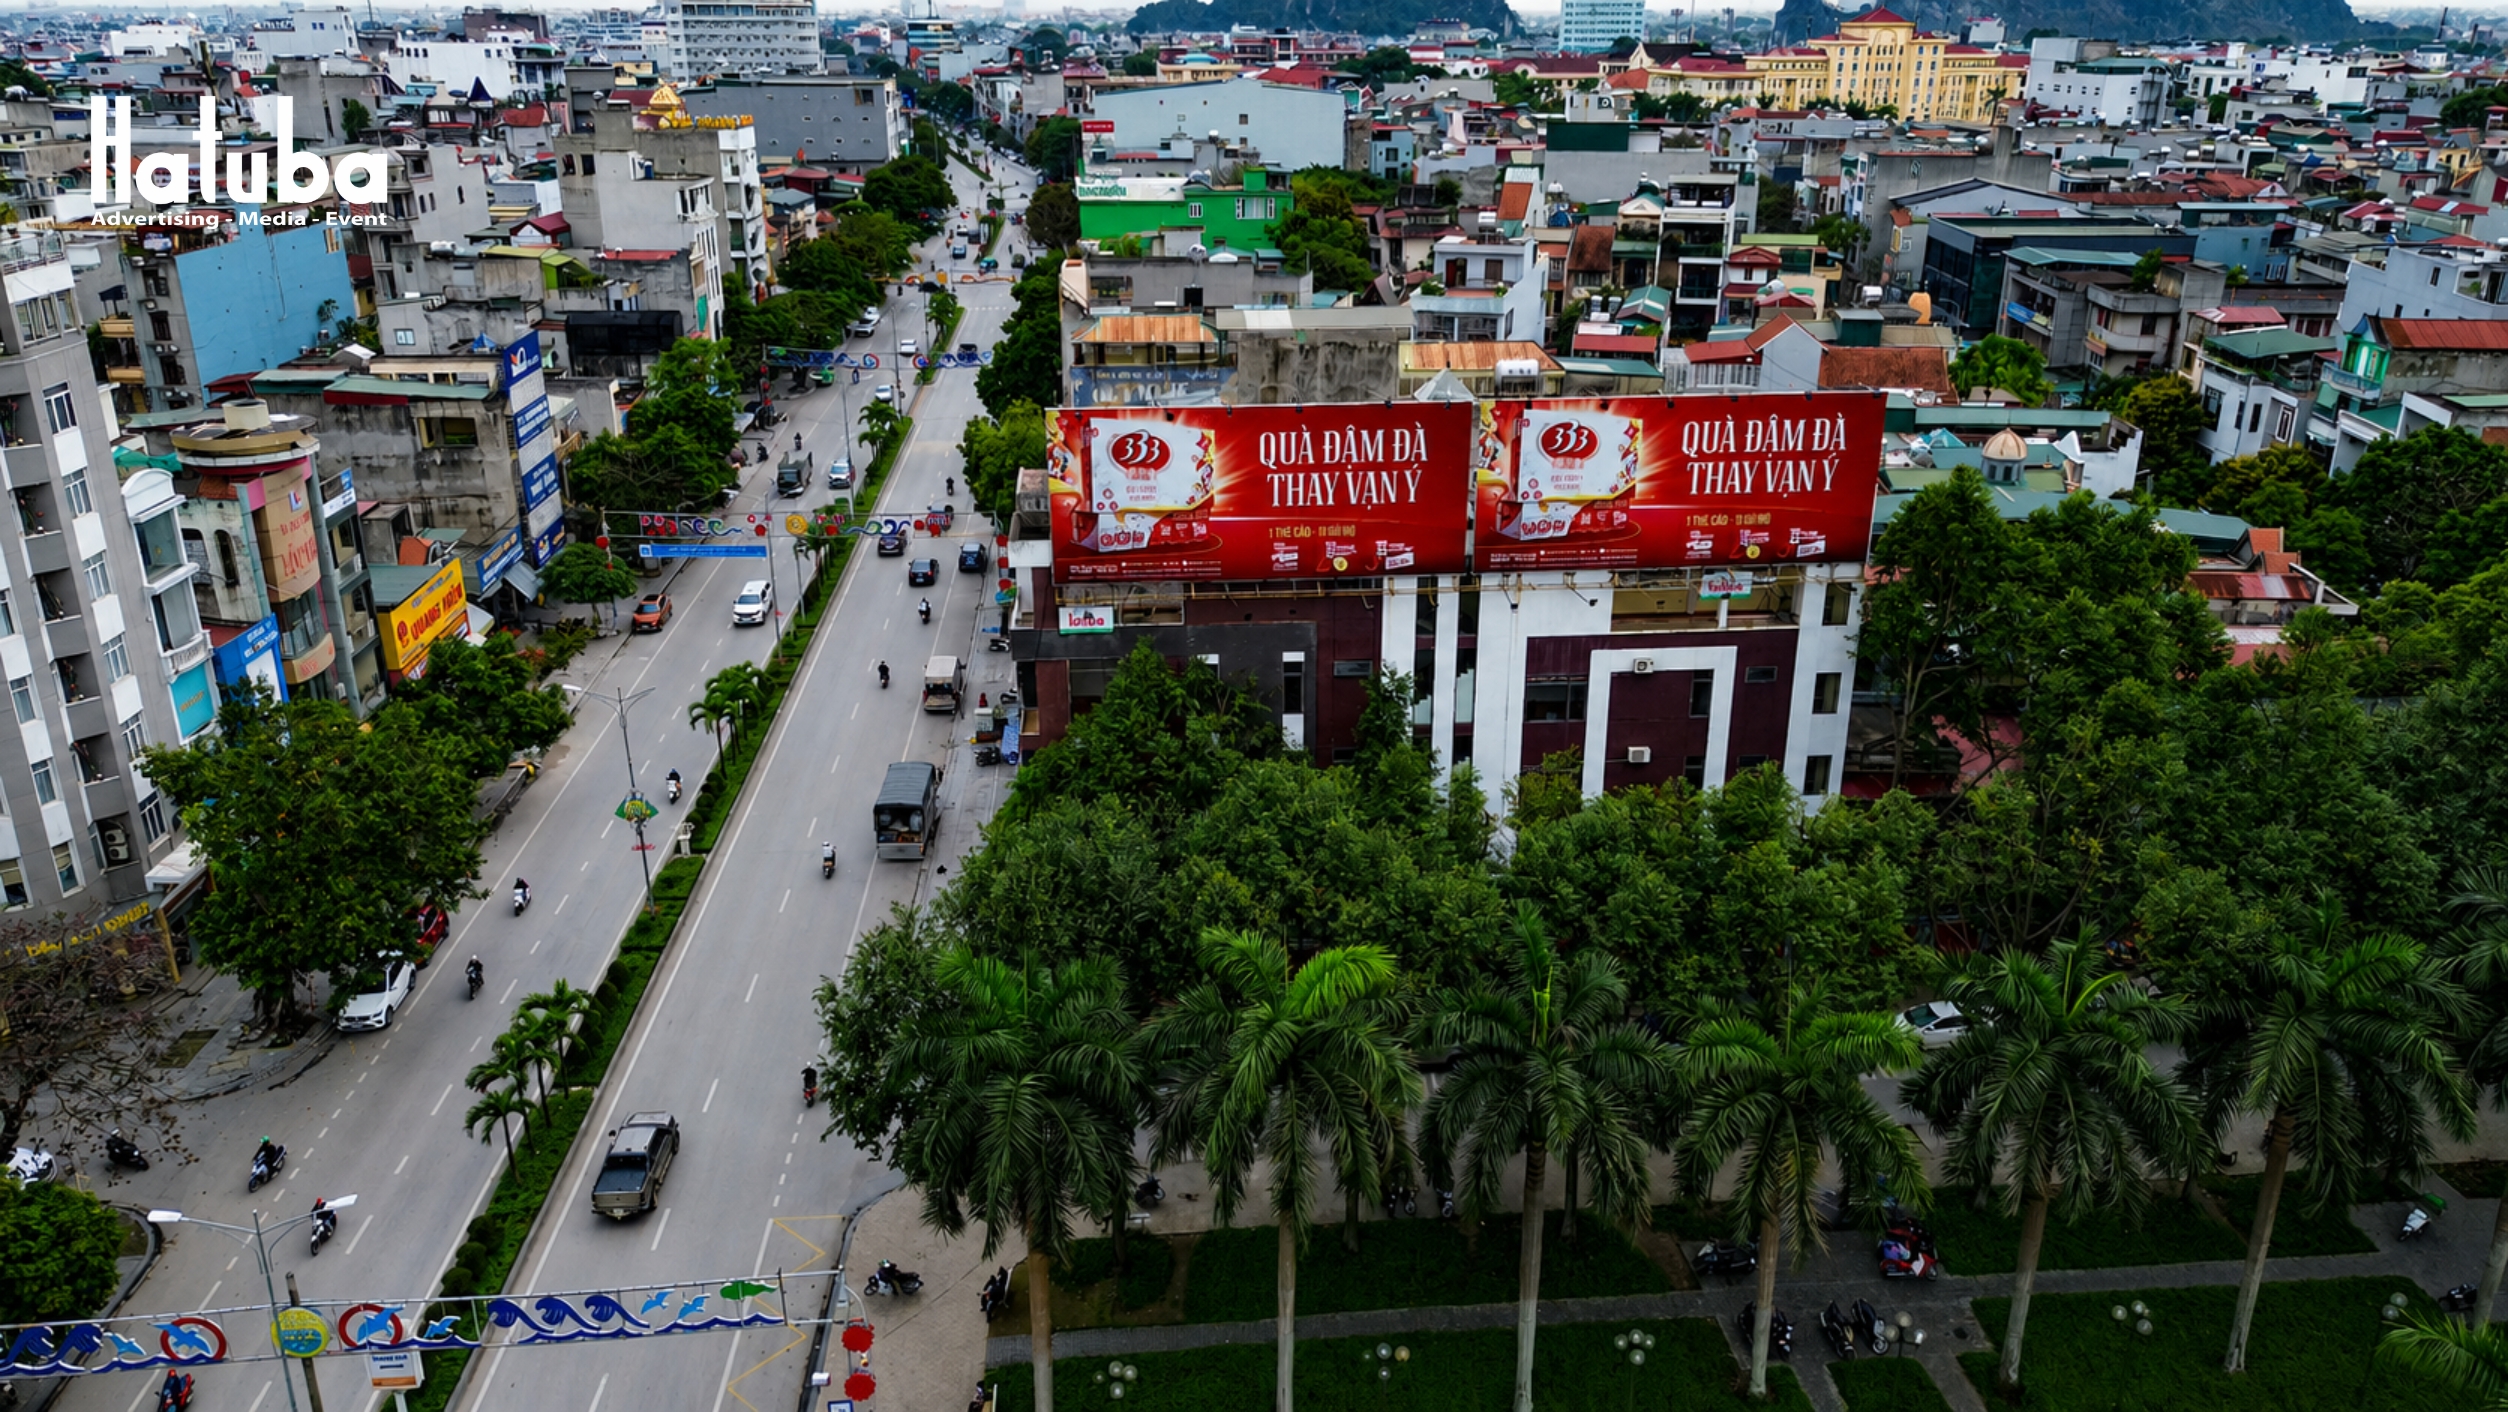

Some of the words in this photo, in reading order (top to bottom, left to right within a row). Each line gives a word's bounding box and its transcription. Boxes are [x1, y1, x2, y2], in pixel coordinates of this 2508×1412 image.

[1118, 430, 1162, 465] 333
[1259, 423, 1315, 470] QUÀ
[1392, 421, 1428, 463] ĐÀ
[1547, 420, 1590, 455] 333
[1681, 413, 1736, 458] QUÀ
[1811, 411, 1847, 452] ĐÀ
[1266, 472, 1341, 508] THAY
[1344, 470, 1398, 512] VẠN
[1403, 462, 1423, 504] Ý
[1686, 460, 1760, 496] THAY
[1764, 459, 1817, 499] VẠN
[1822, 451, 1840, 492] Ý
